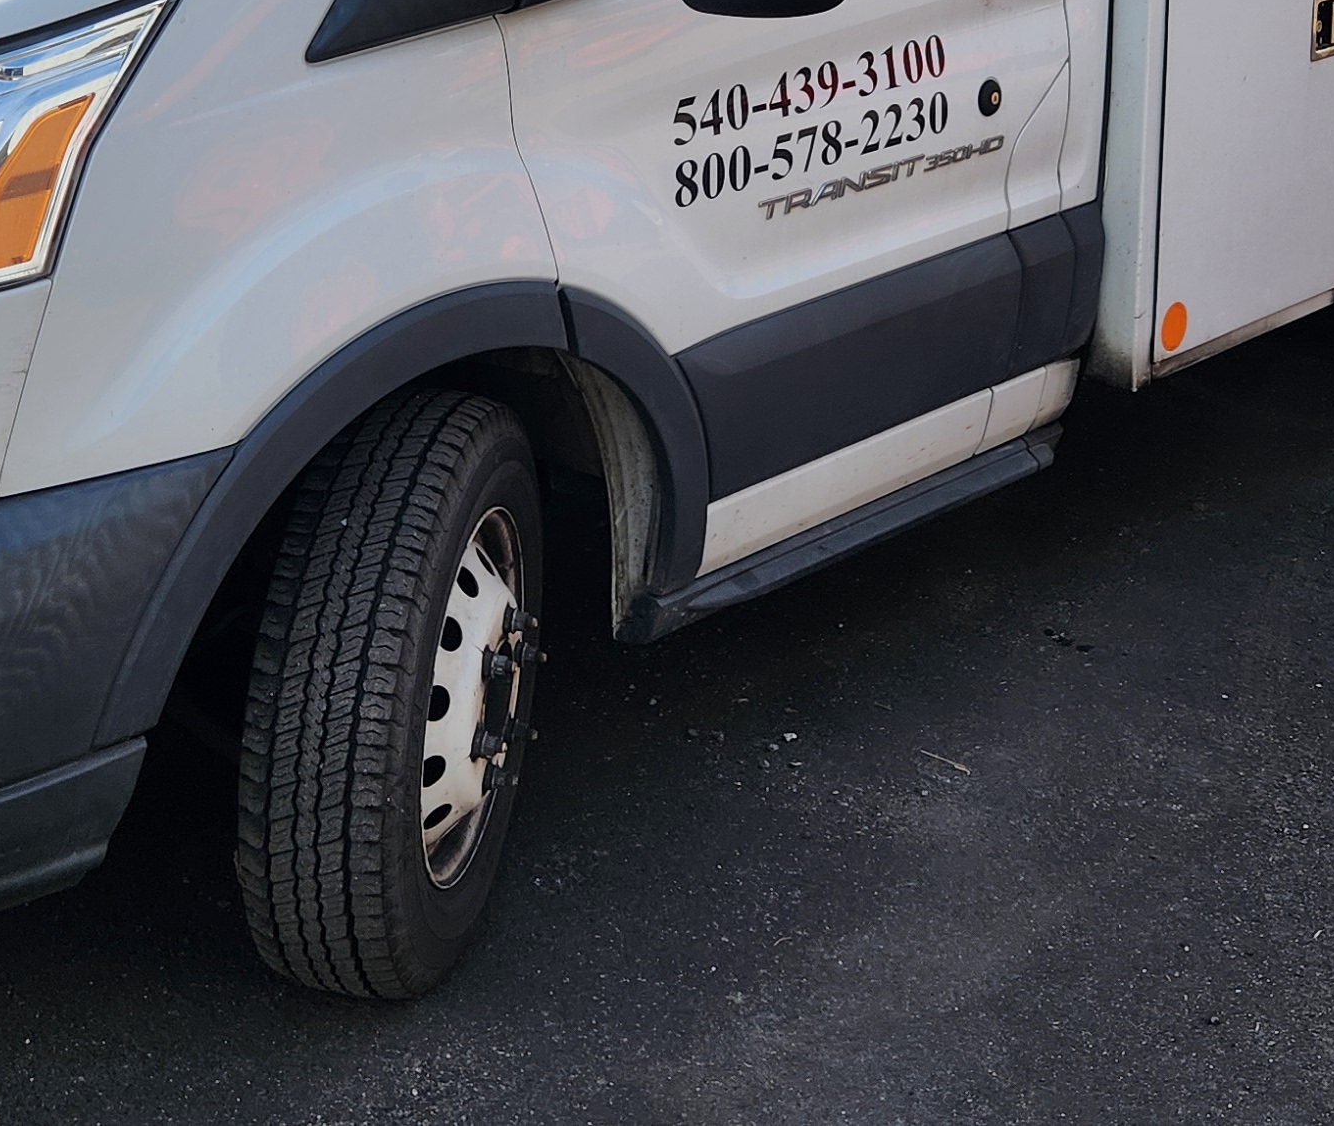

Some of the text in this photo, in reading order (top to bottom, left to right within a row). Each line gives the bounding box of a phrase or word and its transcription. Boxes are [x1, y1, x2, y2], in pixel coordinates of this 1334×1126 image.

[672, 34, 946, 146] 540-439-3100
[674, 91, 949, 208] 800-578-2230
[758, 153, 926, 221] TRANSIT
